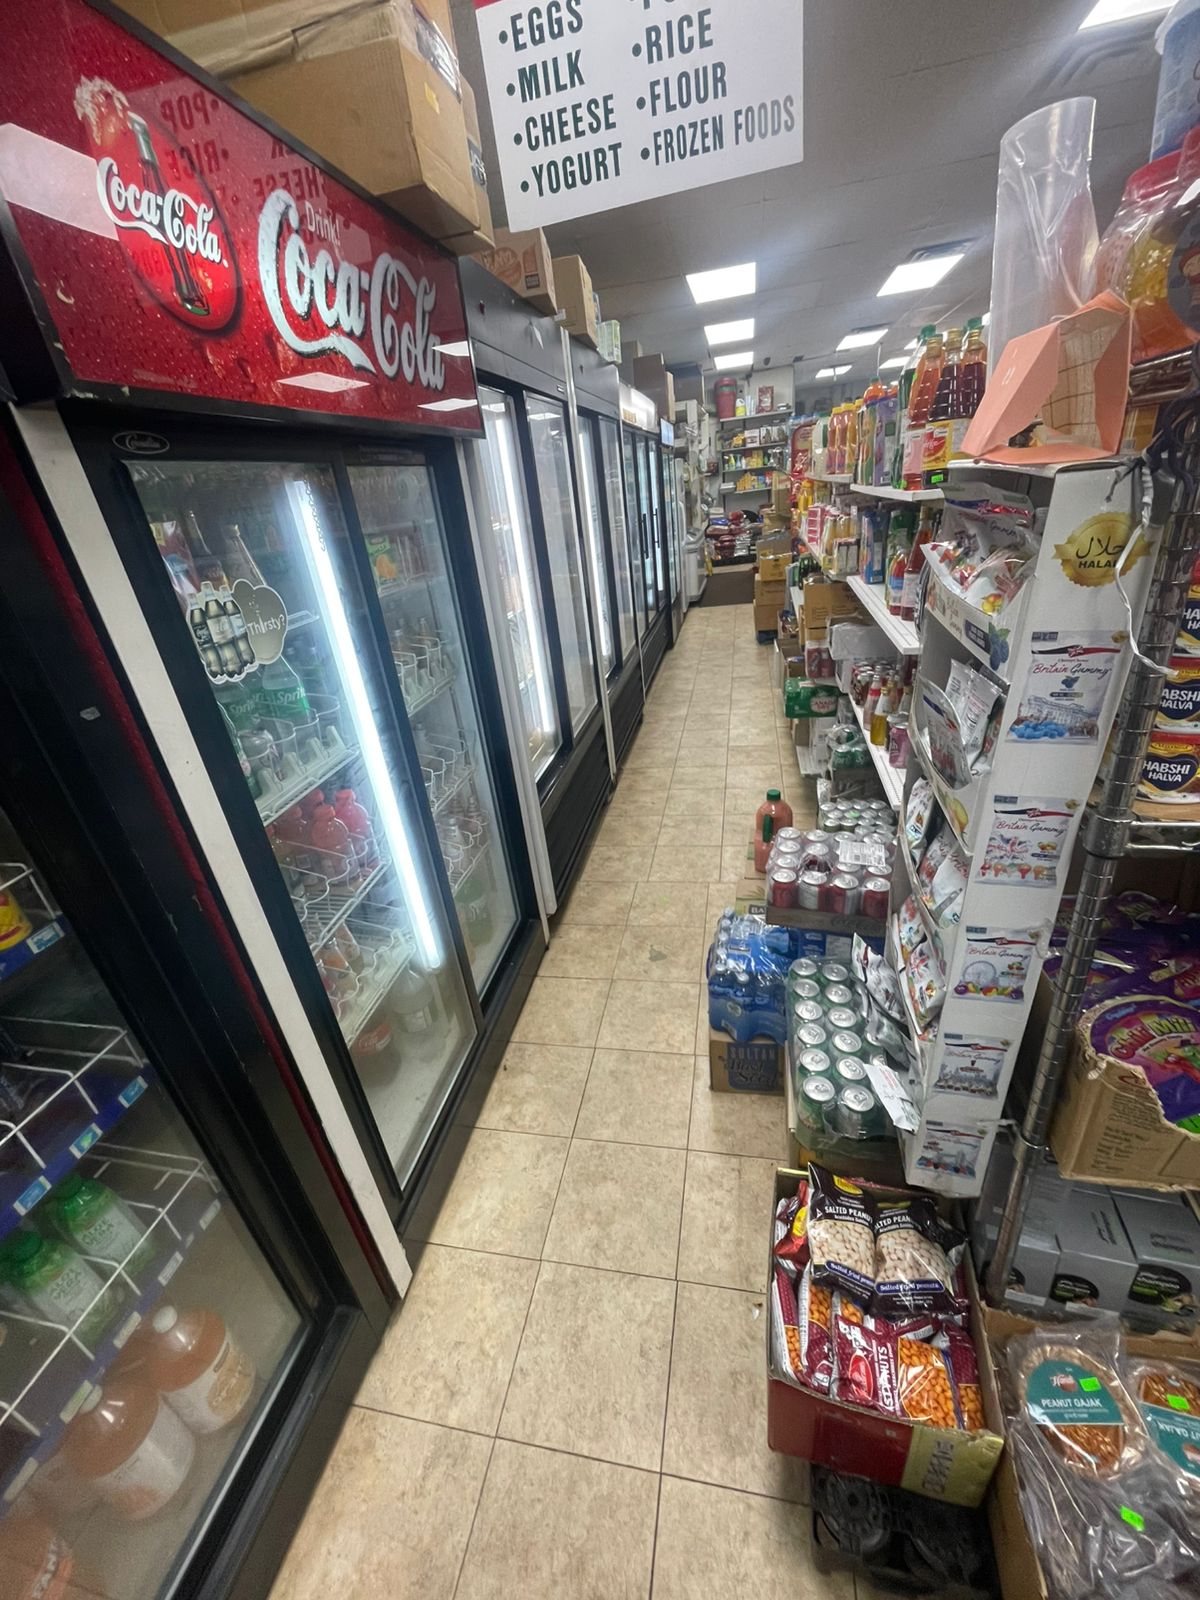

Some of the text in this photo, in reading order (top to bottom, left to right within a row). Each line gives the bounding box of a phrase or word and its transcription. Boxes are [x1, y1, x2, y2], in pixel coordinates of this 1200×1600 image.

[510, 0, 584, 52] EGGS
[645, 8, 714, 64] RICE
[517, 49, 585, 103] MILK
[649, 61, 727, 116] FLOUR
[525, 94, 617, 151] CHEESE
[653, 95, 795, 166] FROZEN FOODS
[531, 142, 622, 197] YOGURT
[97, 157, 223, 264] Coca-Cola
[258, 189, 445, 390] Coca-Cola
[247, 614, 285, 636] Thirsty?
[1033, 662, 1112, 680] Britain Gummy
[1161, 688, 1200, 702] ABSHI
[1142, 760, 1191, 774] HABSHI
[1148, 771, 1182, 782] HALVA
[996, 820, 1028, 831] Britain
[824, 1205, 848, 1215] SALTED
[880, 1283, 899, 1291] Salted
[1041, 1398, 1103, 1408] PEANUT GAJAK
